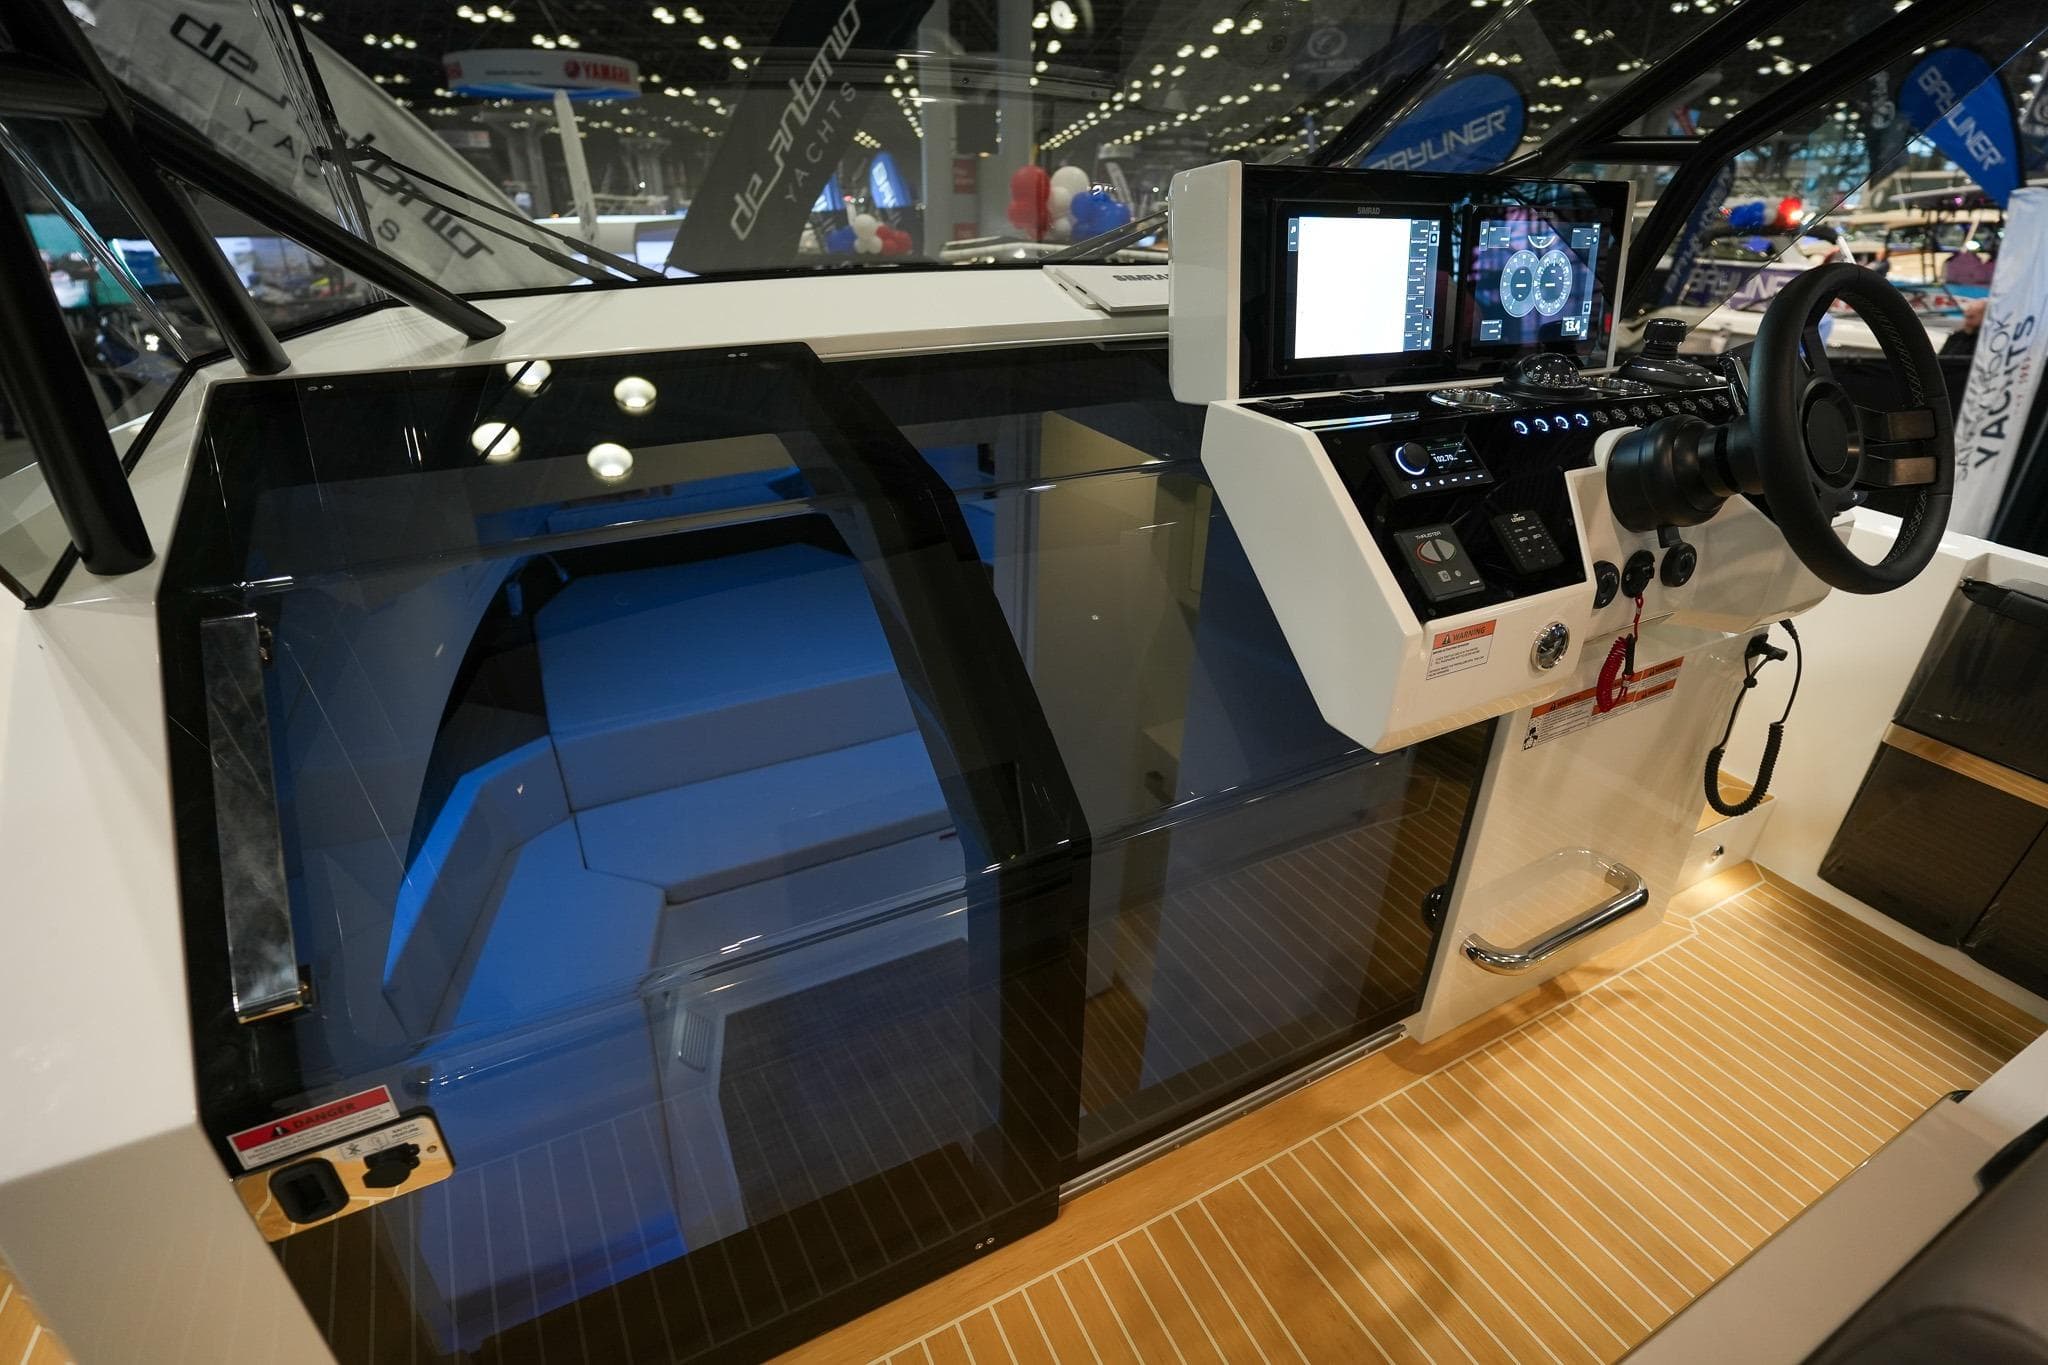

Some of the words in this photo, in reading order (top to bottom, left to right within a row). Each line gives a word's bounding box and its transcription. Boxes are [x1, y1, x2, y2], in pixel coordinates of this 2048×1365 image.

[1917, 65, 2005, 171] BAYLINER
[785, 82, 857, 202] YACHTS
[1357, 206, 1381, 215] SIMRAD
[1453, 626, 1486, 640] WARNING
[293, 1102, 356, 1129] DANGER
